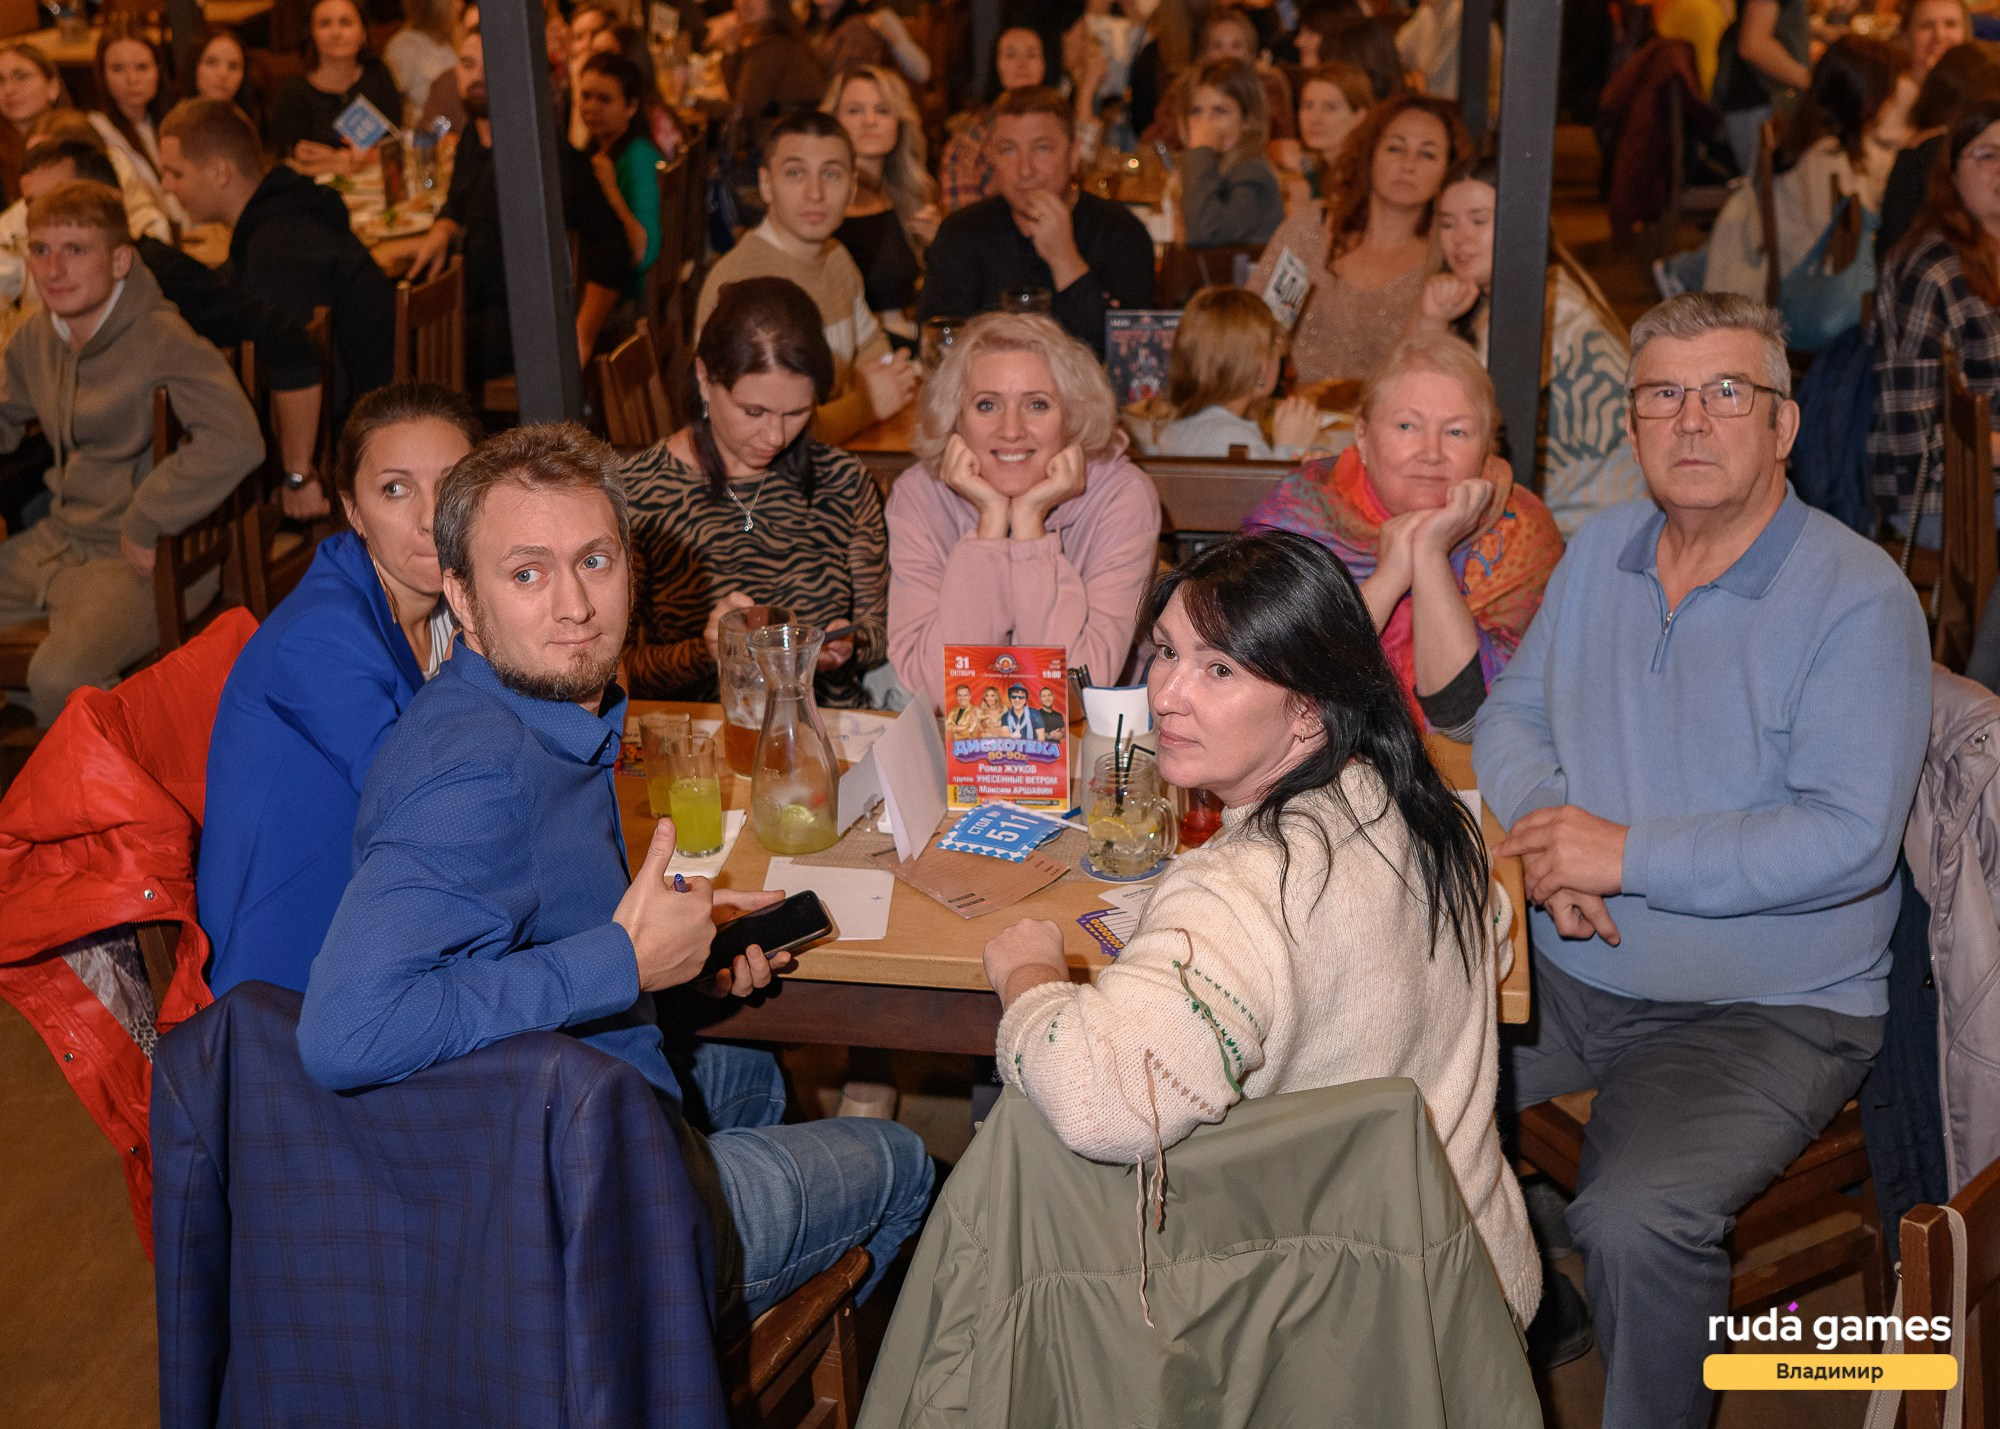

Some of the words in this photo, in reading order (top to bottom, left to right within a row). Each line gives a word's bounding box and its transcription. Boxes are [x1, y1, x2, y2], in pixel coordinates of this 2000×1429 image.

[955, 656, 970, 669] 31
[953, 739, 1060, 757] ДИСКОТЕКА
[978, 764, 1002, 773] Рома
[1004, 764, 1037, 774] ЖУКОВ
[1025, 776, 1058, 785] ВЕТРОМ
[979, 785, 1011, 794] Максим
[1013, 786, 1053, 795] АРШАВИН
[967, 817, 994, 835] СТОЛ
[985, 814, 1040, 842] 511
